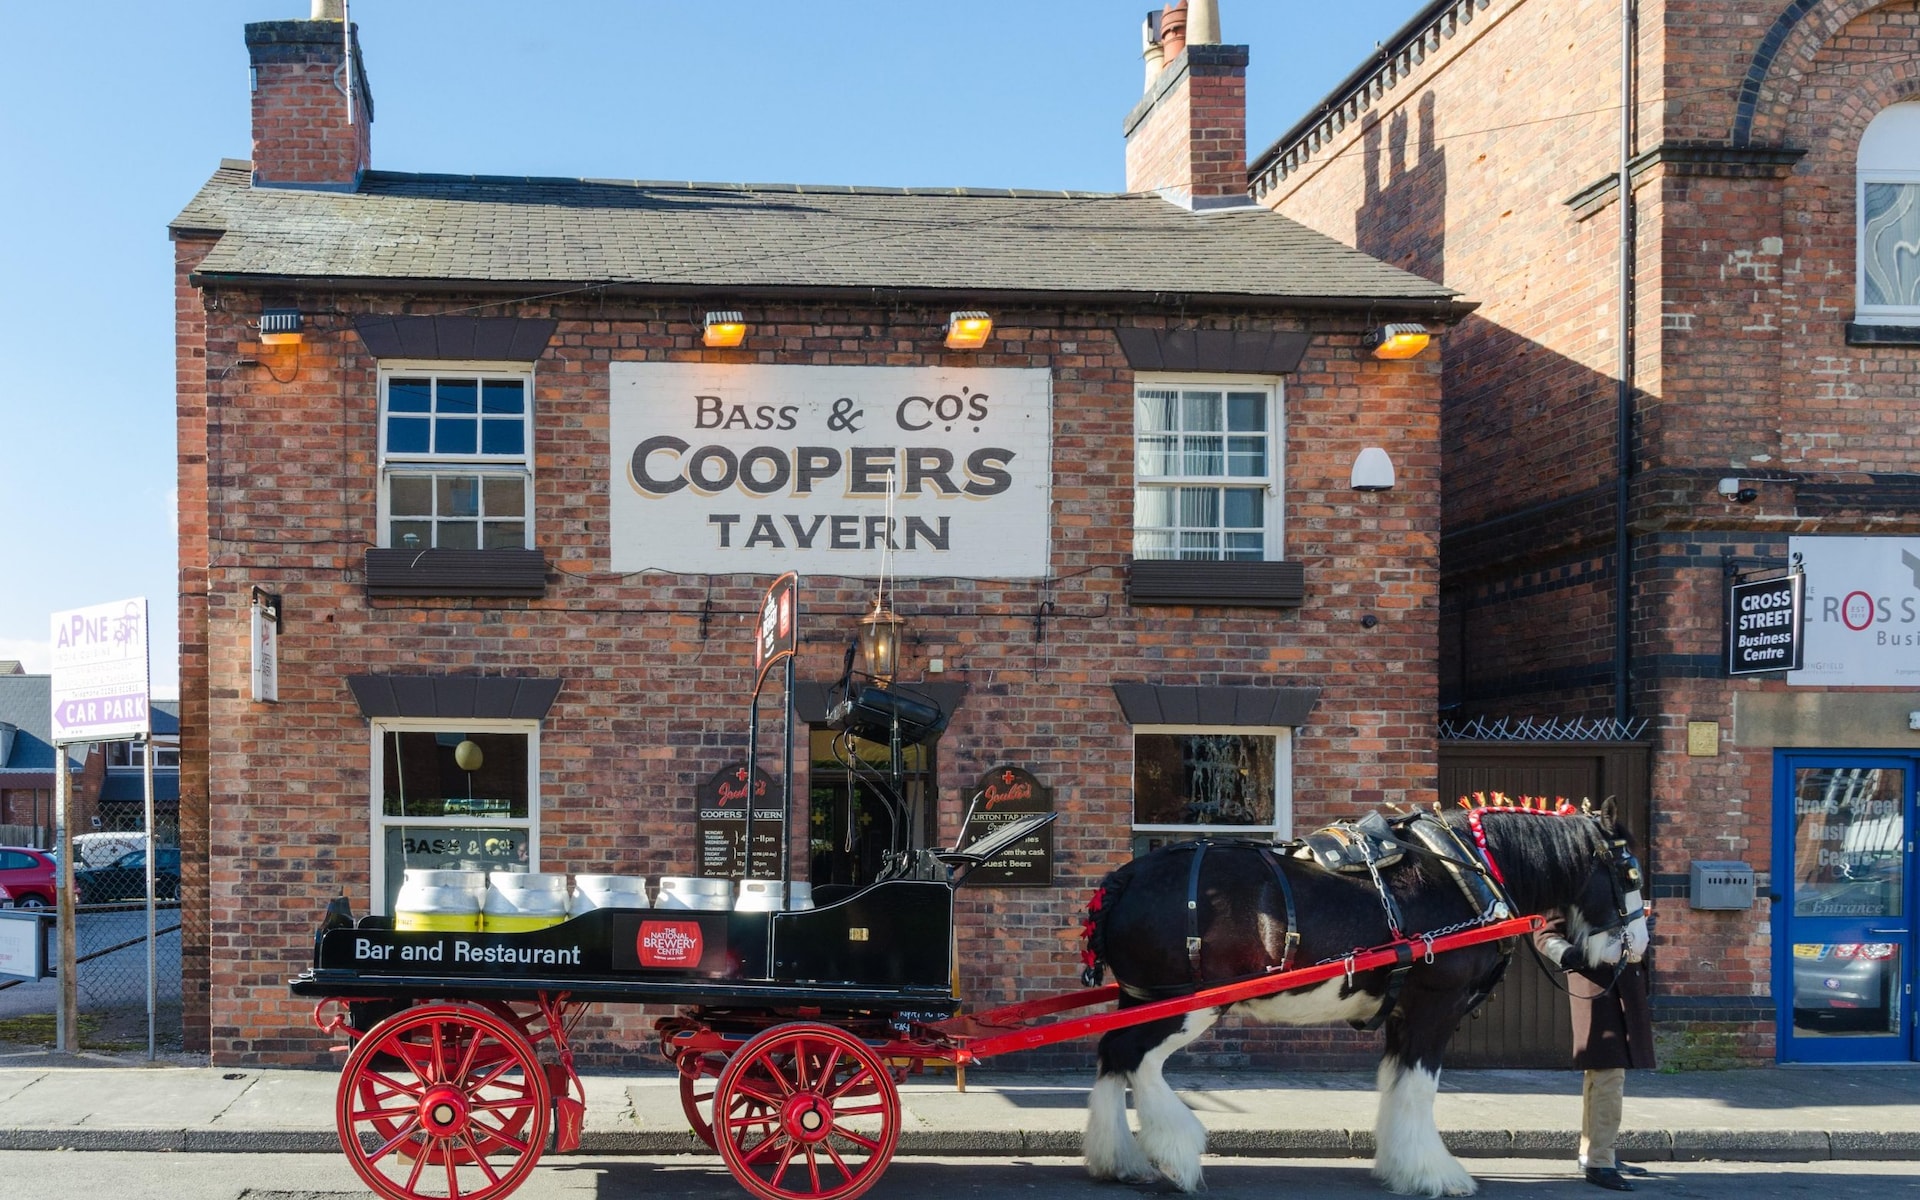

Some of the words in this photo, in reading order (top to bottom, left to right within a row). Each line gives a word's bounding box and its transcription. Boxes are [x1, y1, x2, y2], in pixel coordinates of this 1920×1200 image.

[827, 397, 866, 433] &
[627, 435, 1017, 500] COOPERS
[708, 514, 951, 552] TAVERN
[1741, 590, 1791, 611] CROSS
[1739, 609, 1792, 630] STREET
[1738, 632, 1792, 648] Business
[1743, 647, 1785, 662] Centre
[66, 702, 97, 723] CAR
[103, 697, 145, 720] PARK
[718, 780, 767, 808] Joul's
[1794, 796, 1839, 815] Cross
[700, 811, 743, 819] COOPERS
[745, 811, 783, 819] VERN
[467, 839, 480, 856] &
[1028, 848, 1045, 856] cask
[1009, 860, 1032, 868] Beers
[1812, 900, 1885, 914] Entrance
[643, 937, 697, 949] BREWERY
[650, 932, 689, 940] NATIONAL
[355, 939, 394, 960] Bar
[400, 941, 443, 962] and
[454, 940, 581, 965] Restaurant
